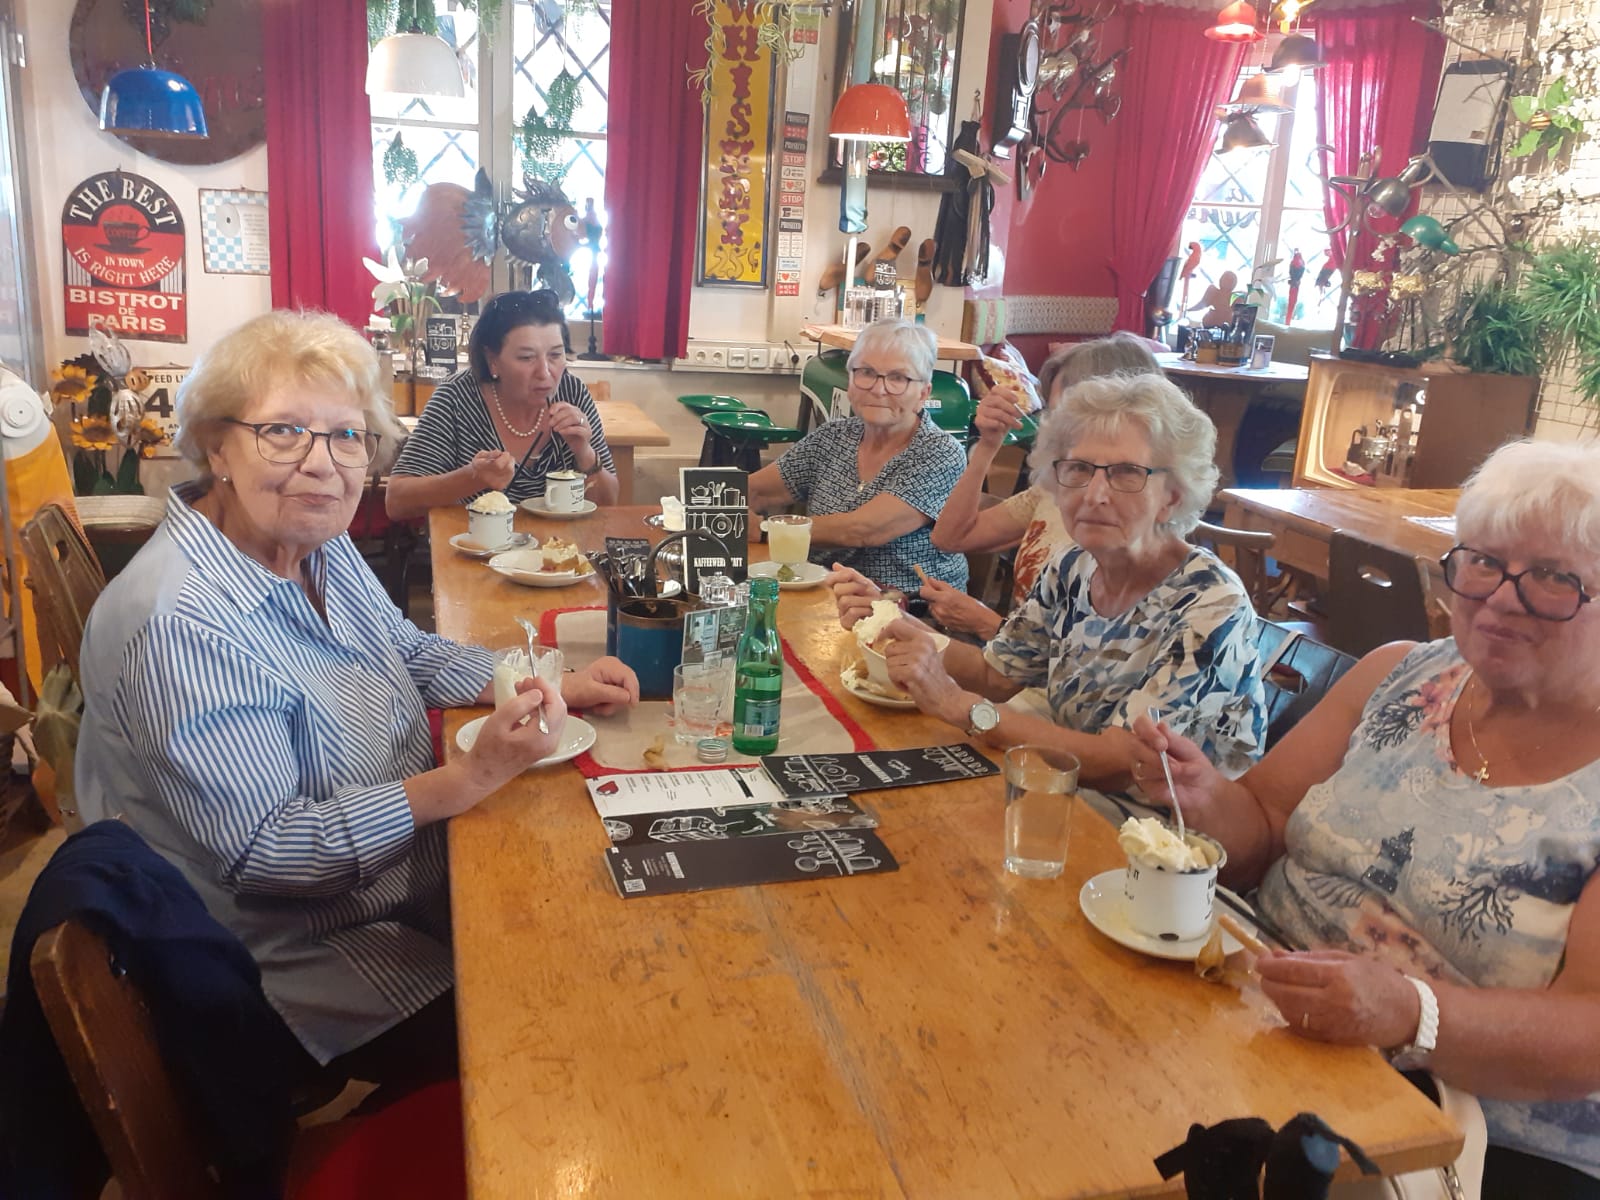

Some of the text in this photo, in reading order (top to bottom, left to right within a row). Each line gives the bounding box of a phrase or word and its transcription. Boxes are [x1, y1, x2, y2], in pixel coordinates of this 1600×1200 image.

[70, 178, 178, 226] THE BEST
[782, 194, 802, 204] STOP
[74, 248, 175, 285] IS RIGHT HERE
[105, 255, 145, 268] IN TOWN
[69, 288, 182, 310] BISTROT
[118, 306, 136, 316] DE
[88, 313, 167, 332] PARIS
[145, 388, 174, 418] 4
